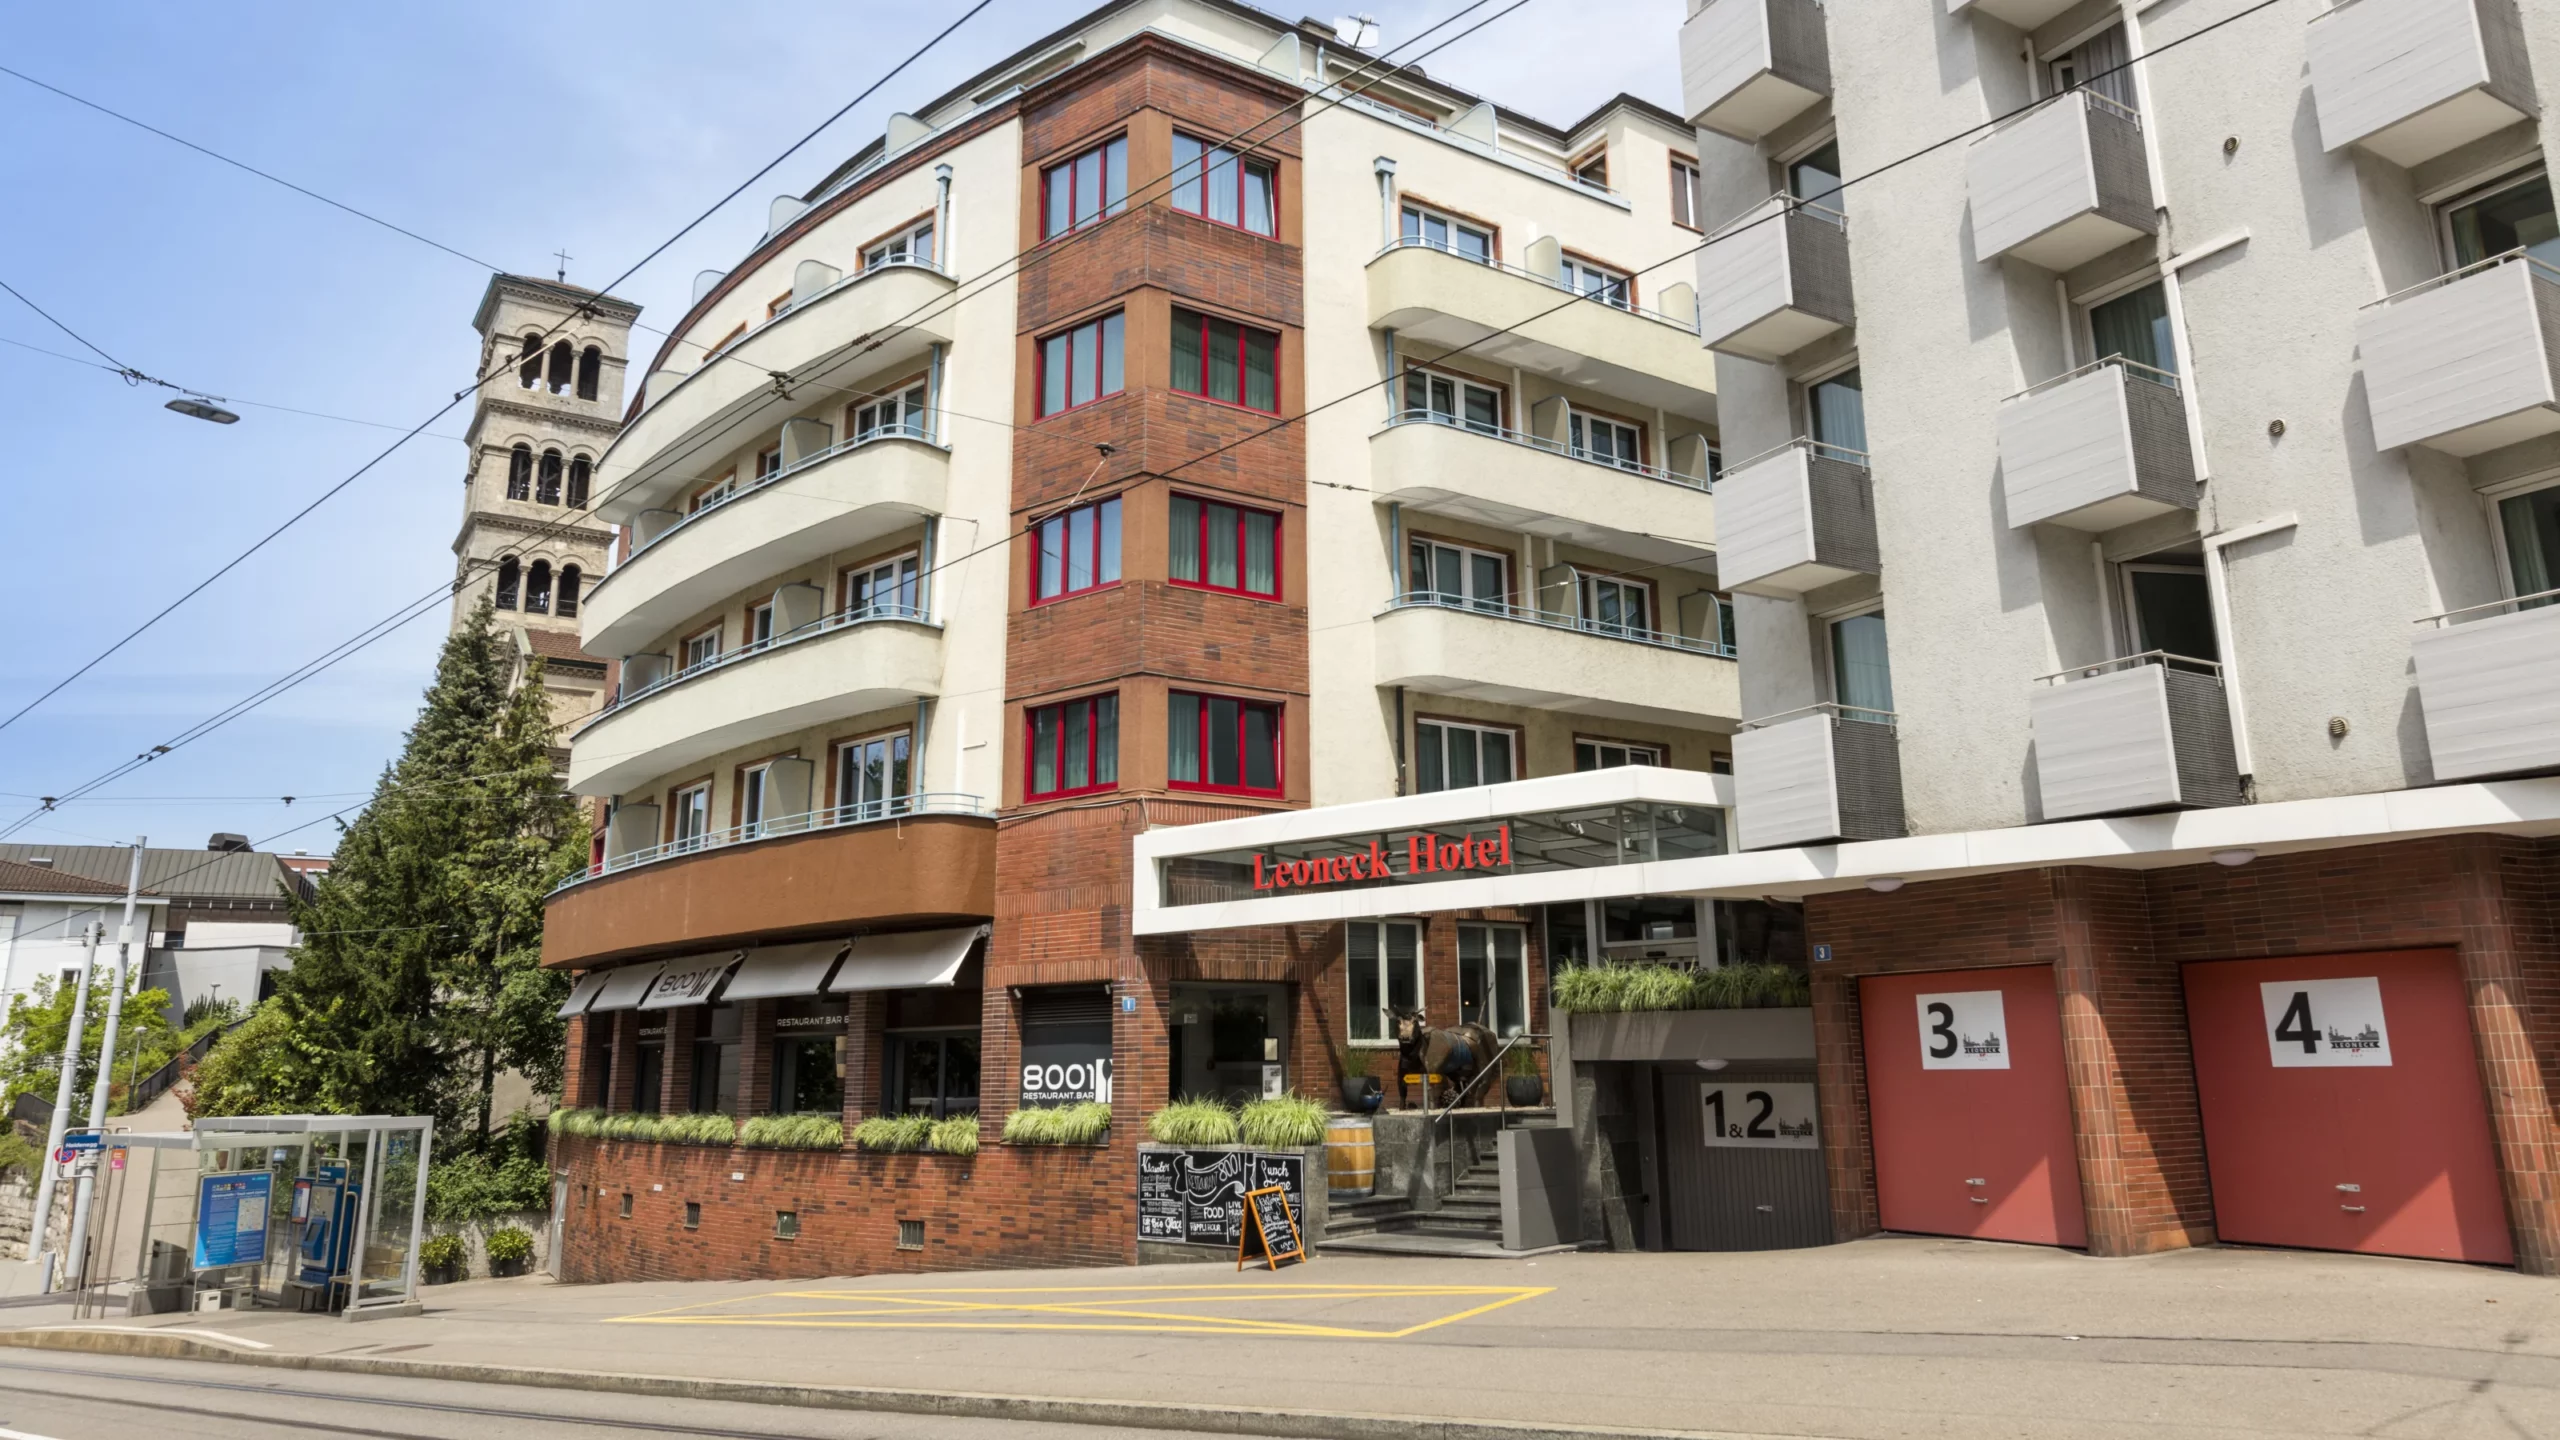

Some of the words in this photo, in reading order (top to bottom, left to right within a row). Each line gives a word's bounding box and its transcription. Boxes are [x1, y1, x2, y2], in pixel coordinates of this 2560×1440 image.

[1252, 840, 1390, 891] Leoneck
[1407, 825, 1511, 875] Hotel
[1819, 947, 1825, 959] 3
[659, 971, 703, 993] 8001
[1126, 1000, 1131, 1010] 1
[1927, 1002, 1958, 1059] 3
[2275, 991, 2322, 1054] 4
[1023, 1063, 1095, 1091] 8001
[1705, 1090, 1726, 1137] 1
[1729, 1124, 1744, 1138] &
[1746, 1091, 1776, 1139] 2
[1219, 1154, 1242, 1182] 8001
[1261, 1160, 1290, 1181] Lunch
[1203, 1206, 1224, 1219] FOOD
[1229, 1201, 1242, 1209] LIVE
